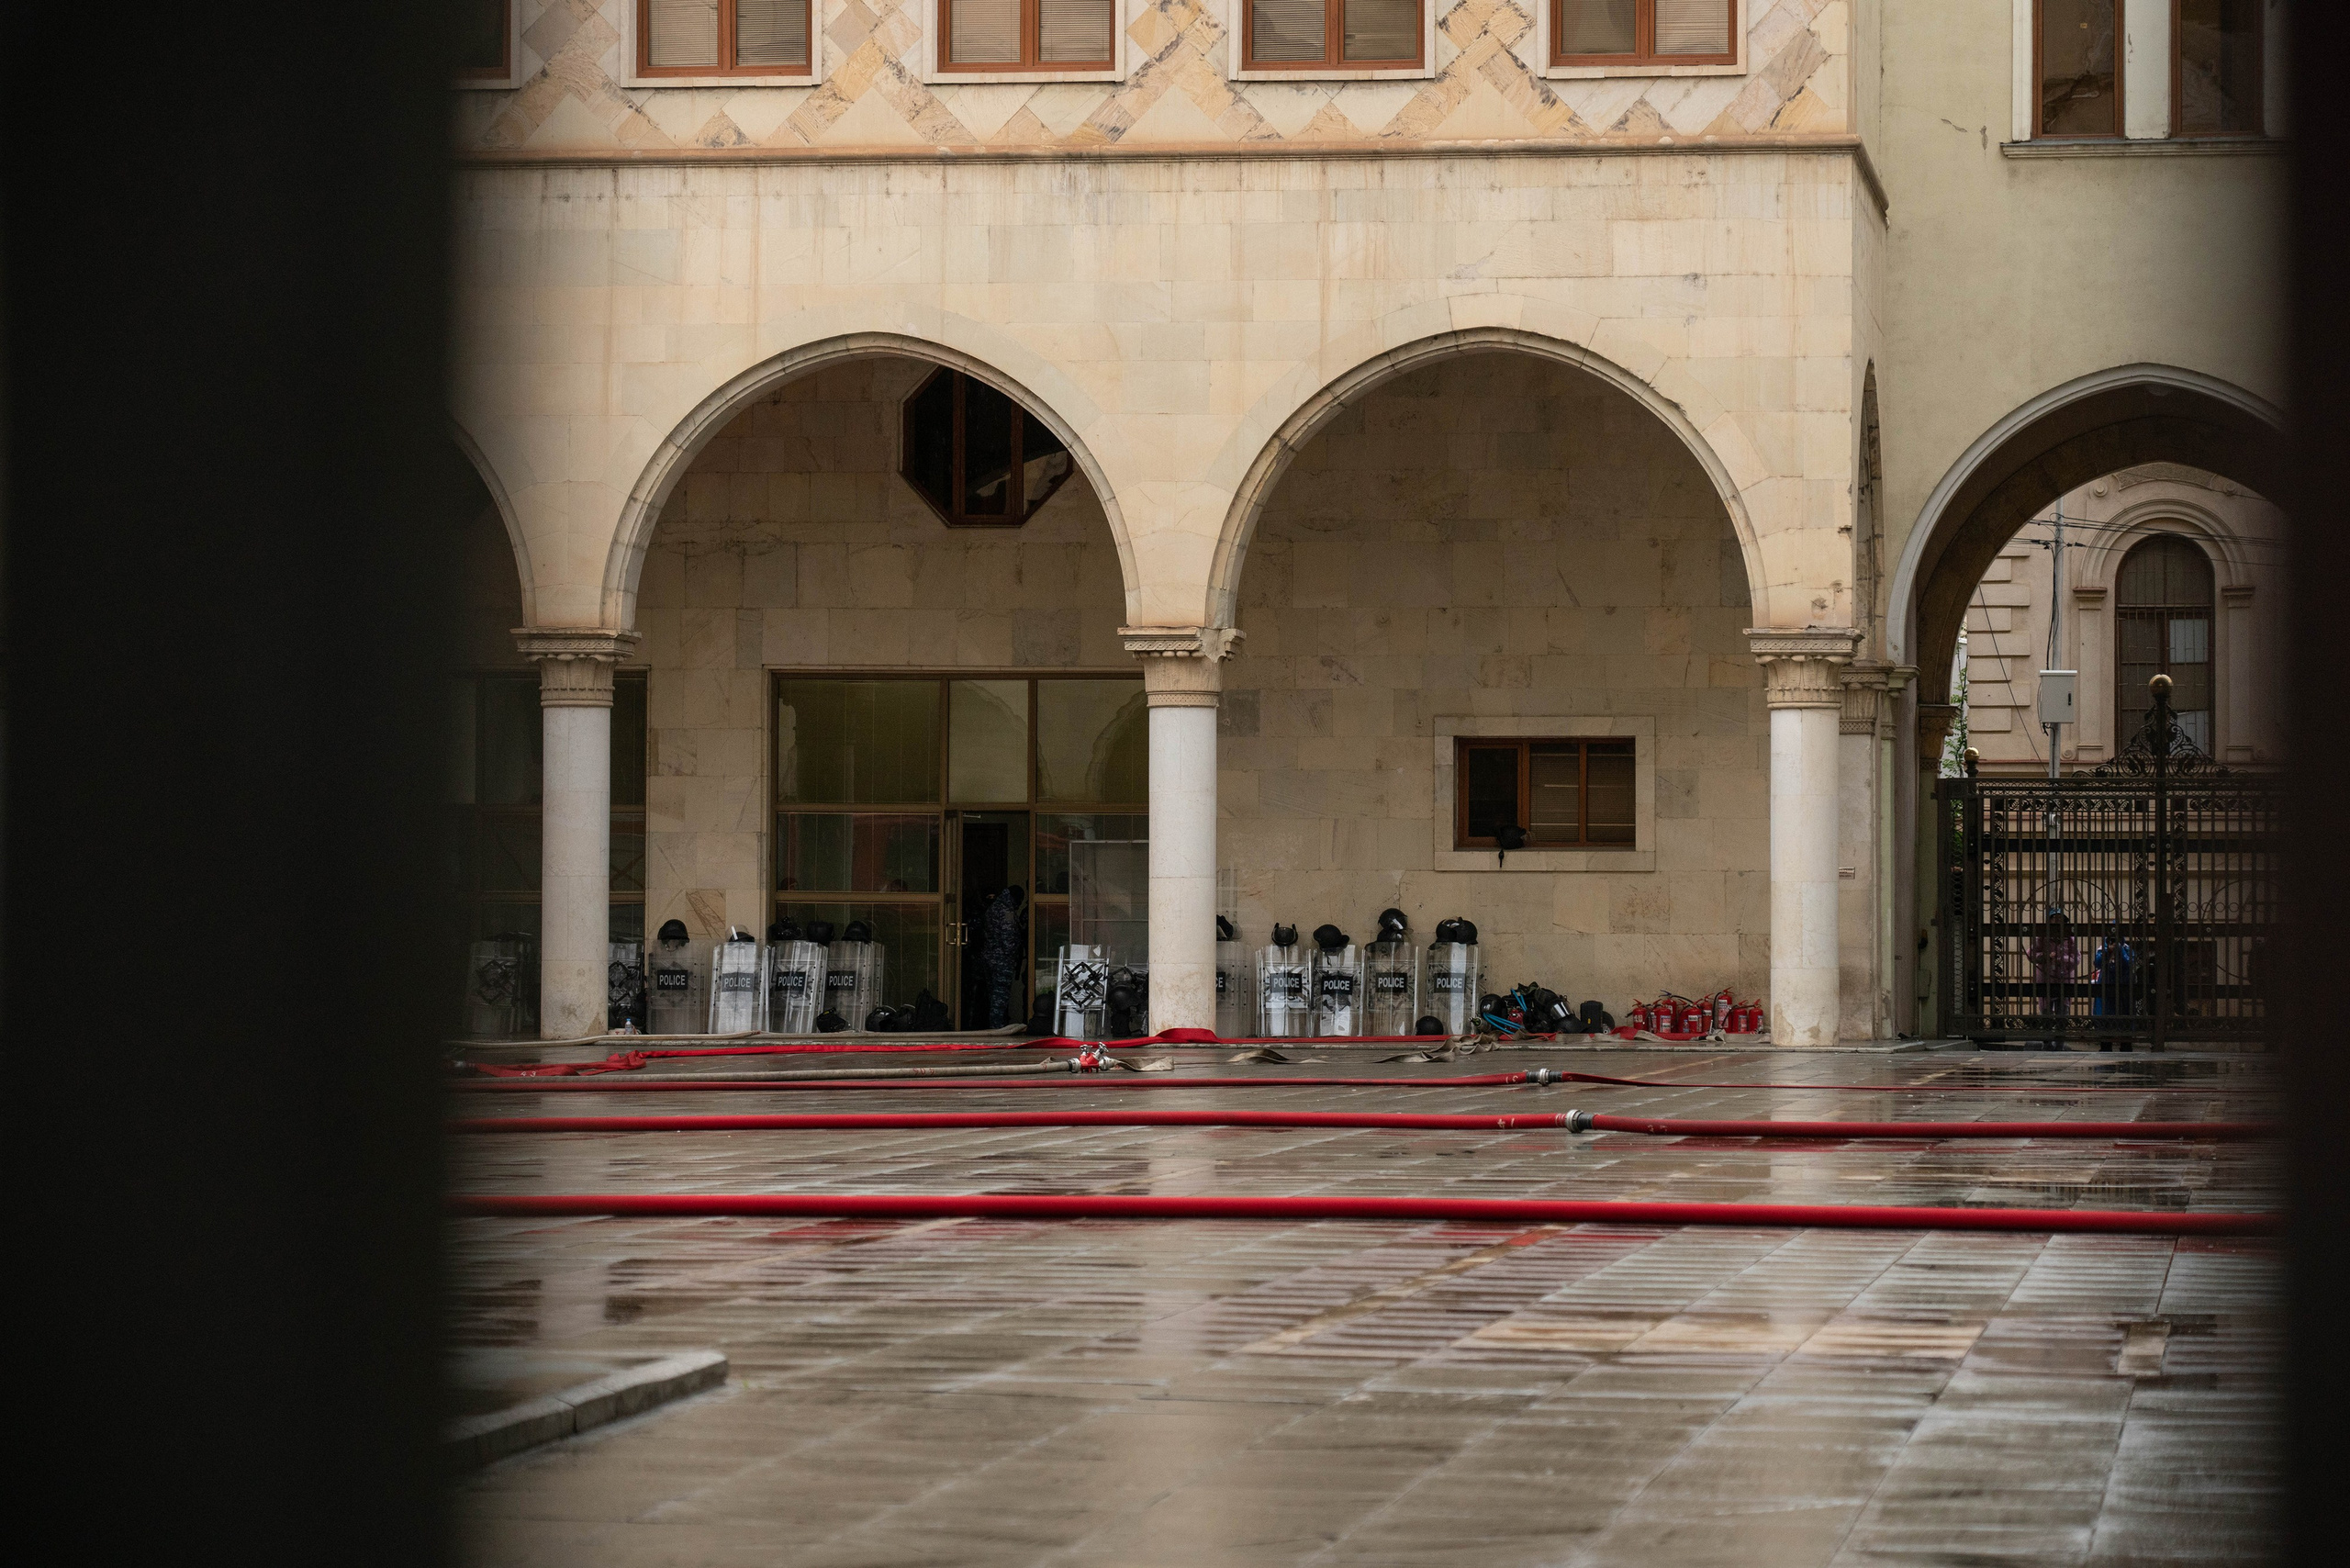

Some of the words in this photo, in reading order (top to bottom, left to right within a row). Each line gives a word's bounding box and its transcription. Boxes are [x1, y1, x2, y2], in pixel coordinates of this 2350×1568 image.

[658, 974, 687, 987] POLICE
[724, 977, 752, 989] POLICE
[778, 975, 804, 988] POLICE
[829, 974, 855, 987] POLICE
[1215, 977, 1224, 988] E
[1273, 977, 1300, 989] POLICE
[1323, 980, 1350, 991] POLICE
[1378, 977, 1405, 989] POLICE
[1437, 977, 1464, 989] POLICE
